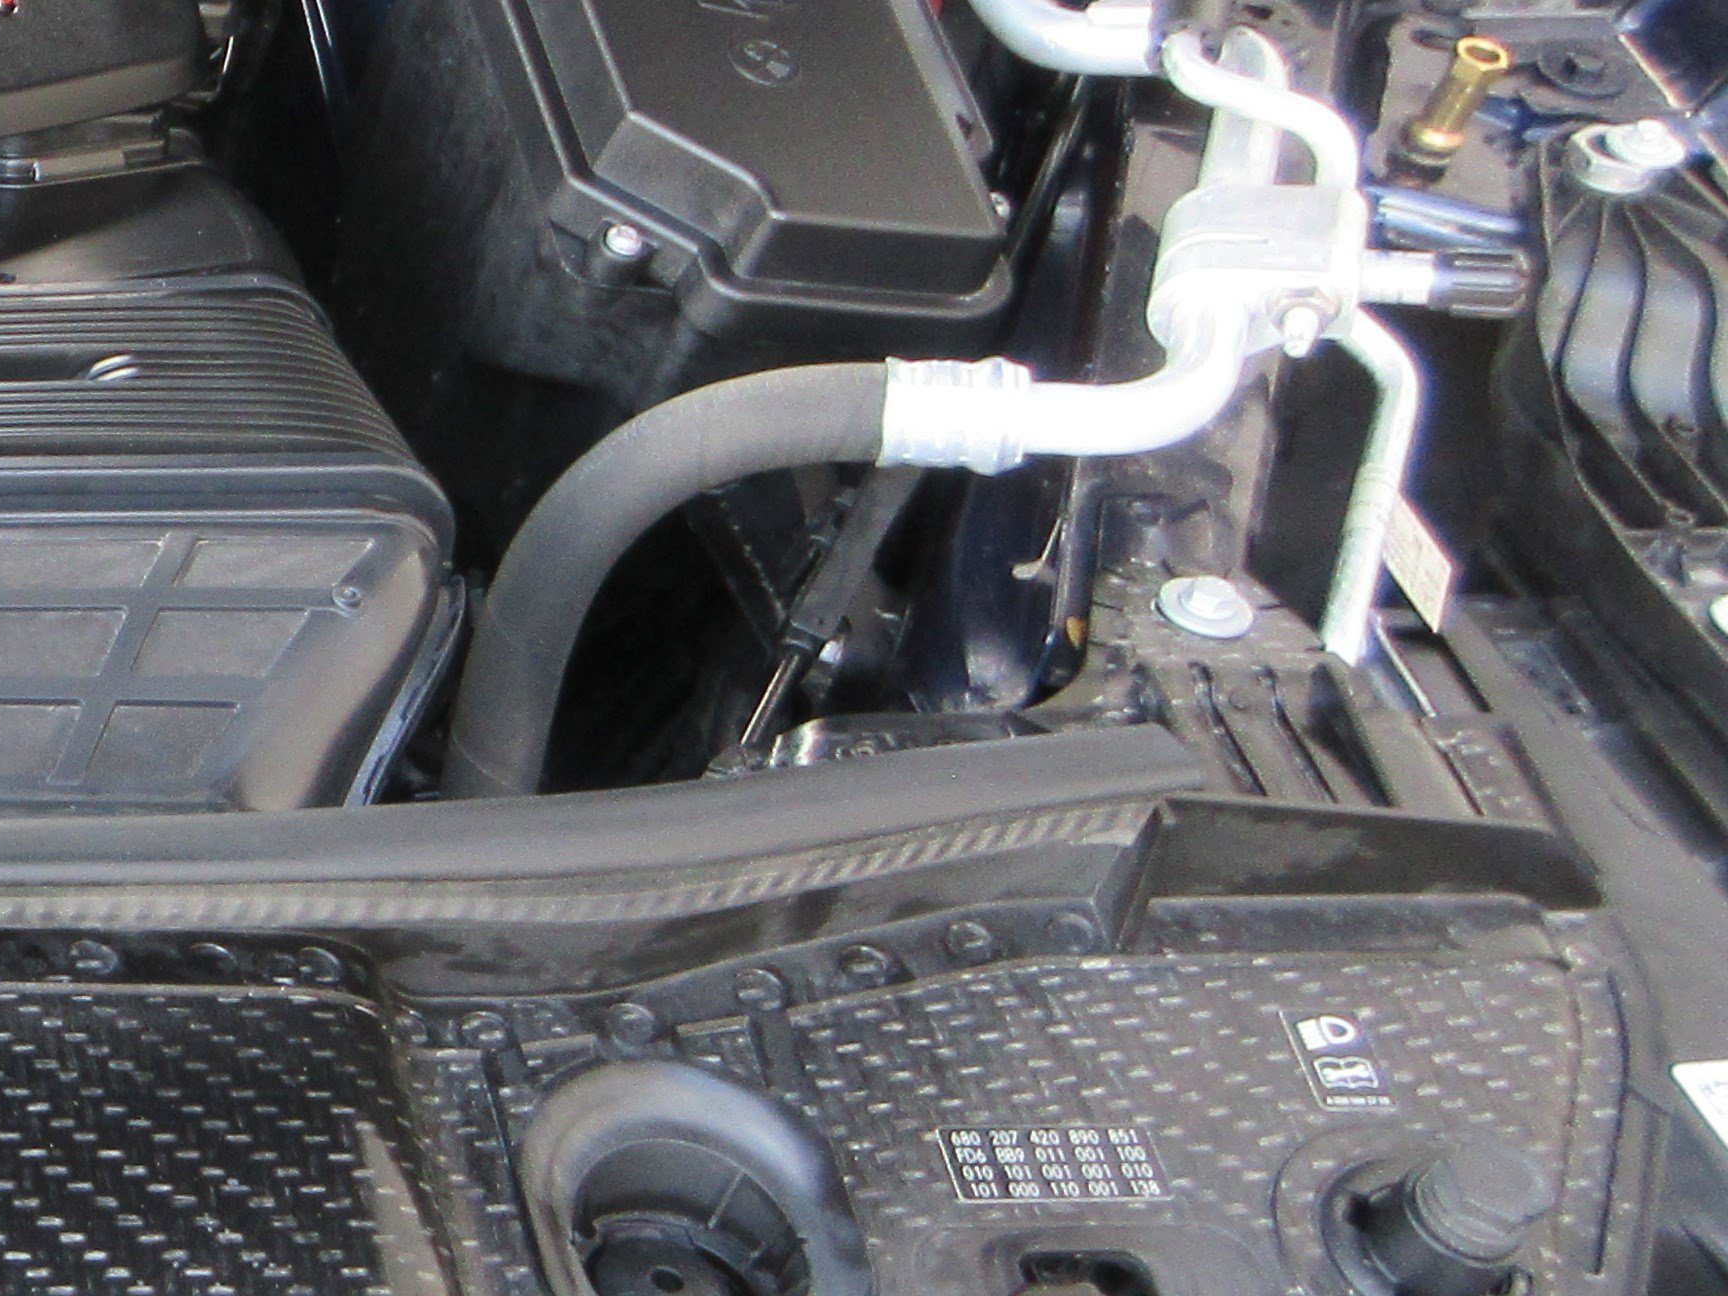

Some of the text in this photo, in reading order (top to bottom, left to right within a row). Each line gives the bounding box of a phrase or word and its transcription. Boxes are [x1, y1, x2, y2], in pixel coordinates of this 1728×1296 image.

[1034, 1147, 1065, 1162] 011
[1075, 1147, 1105, 1161] 001
[1116, 1146, 1146, 1161] 100
[962, 1163, 1153, 1180] 010 101 001 001 010
[971, 1182, 998, 1197] 101
[1049, 1181, 1079, 1196] 110
[1088, 1181, 1119, 1196] 001
